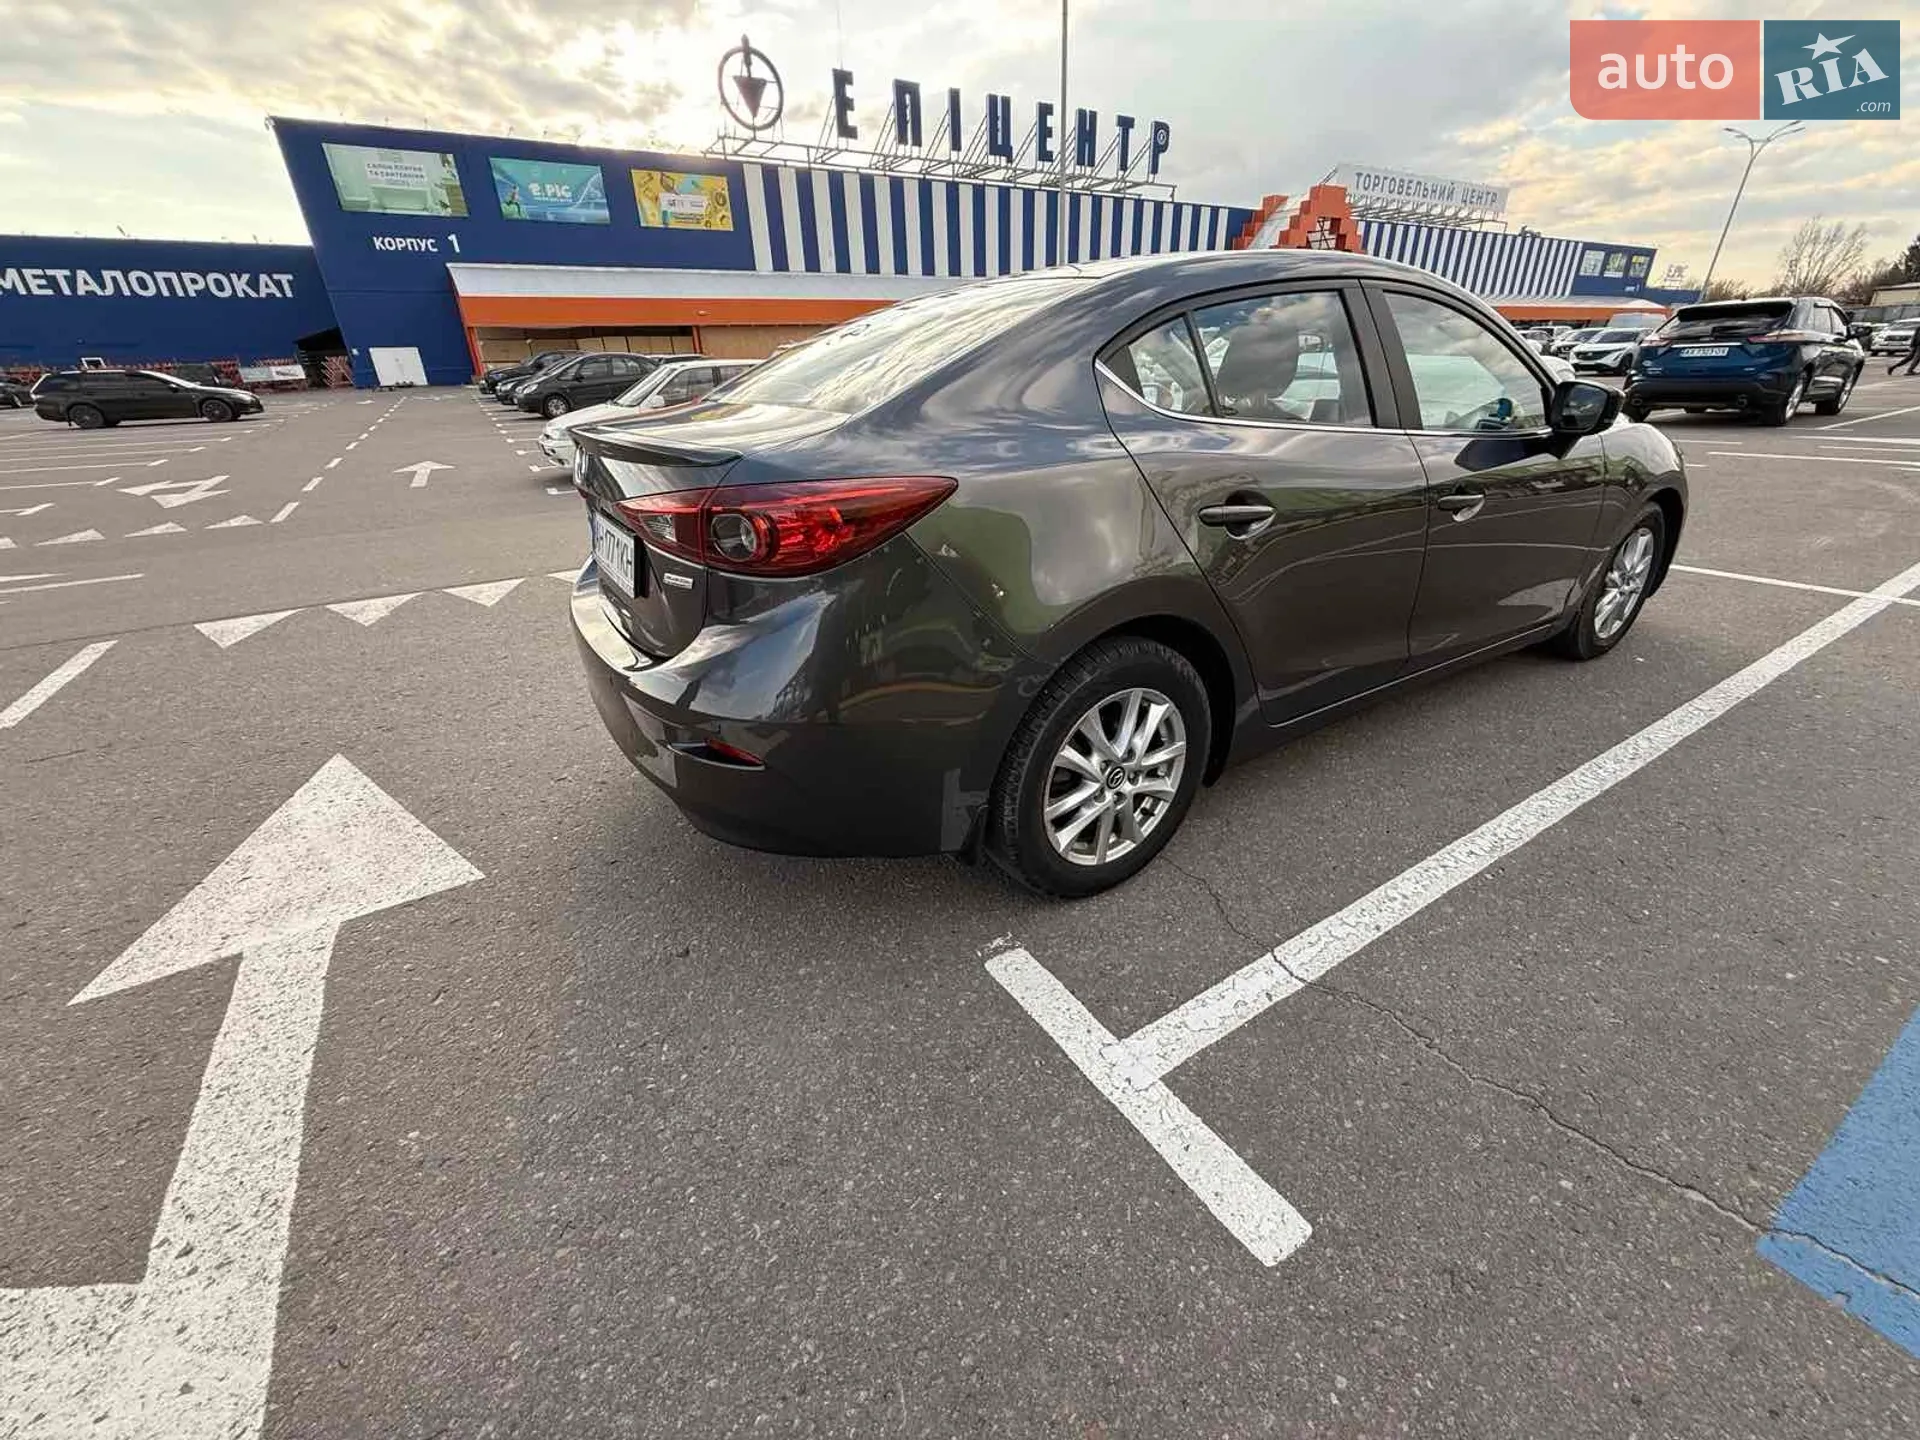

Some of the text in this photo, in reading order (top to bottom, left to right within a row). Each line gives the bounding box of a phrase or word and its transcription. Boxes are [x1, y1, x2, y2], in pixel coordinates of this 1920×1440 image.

[832, 67, 1170, 175] ЕПІЦЕНТР
[1355, 172, 1498, 208] ТОРГОВЕЛЬНИЙ ЦЕНТР
[373, 233, 460, 253] КОРПУС 1
[0, 267, 294, 298] МЕТАЛОПРОКАТ
